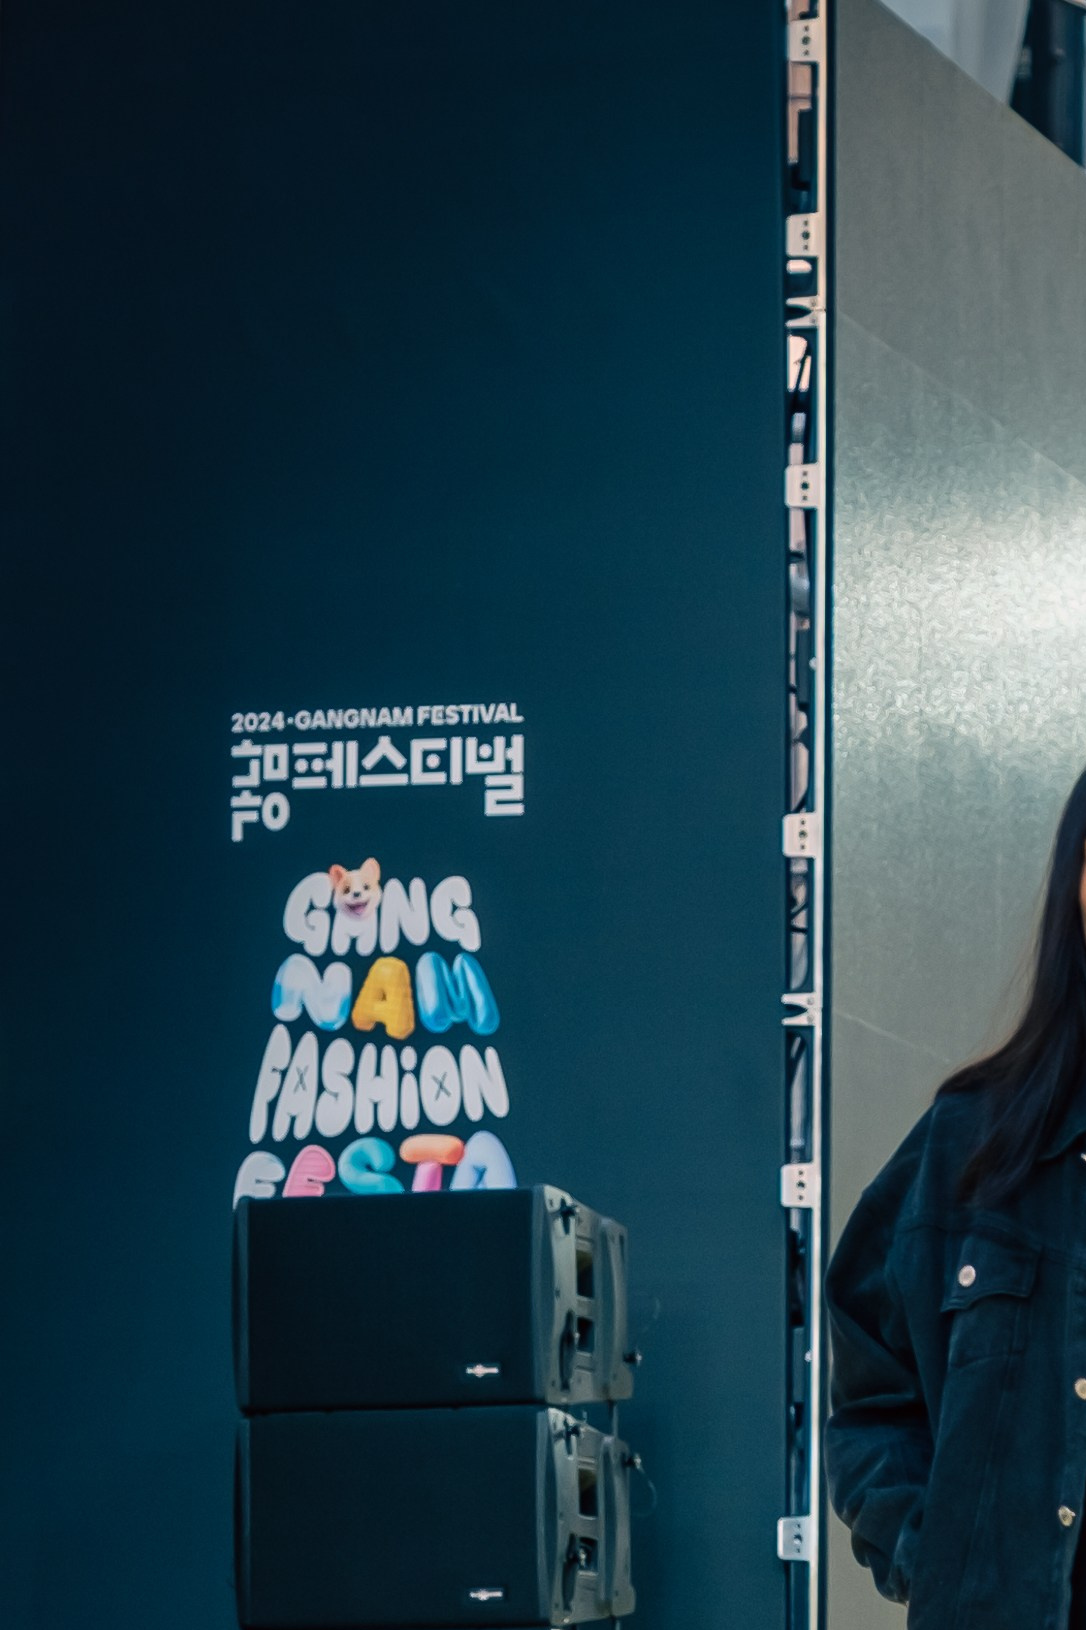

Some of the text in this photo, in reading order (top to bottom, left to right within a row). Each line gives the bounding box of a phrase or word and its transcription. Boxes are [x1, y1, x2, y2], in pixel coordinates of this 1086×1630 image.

[416, 703, 524, 727] FESTIVAL
[283, 872, 481, 957] GANG
[271, 952, 501, 1040] NAM
